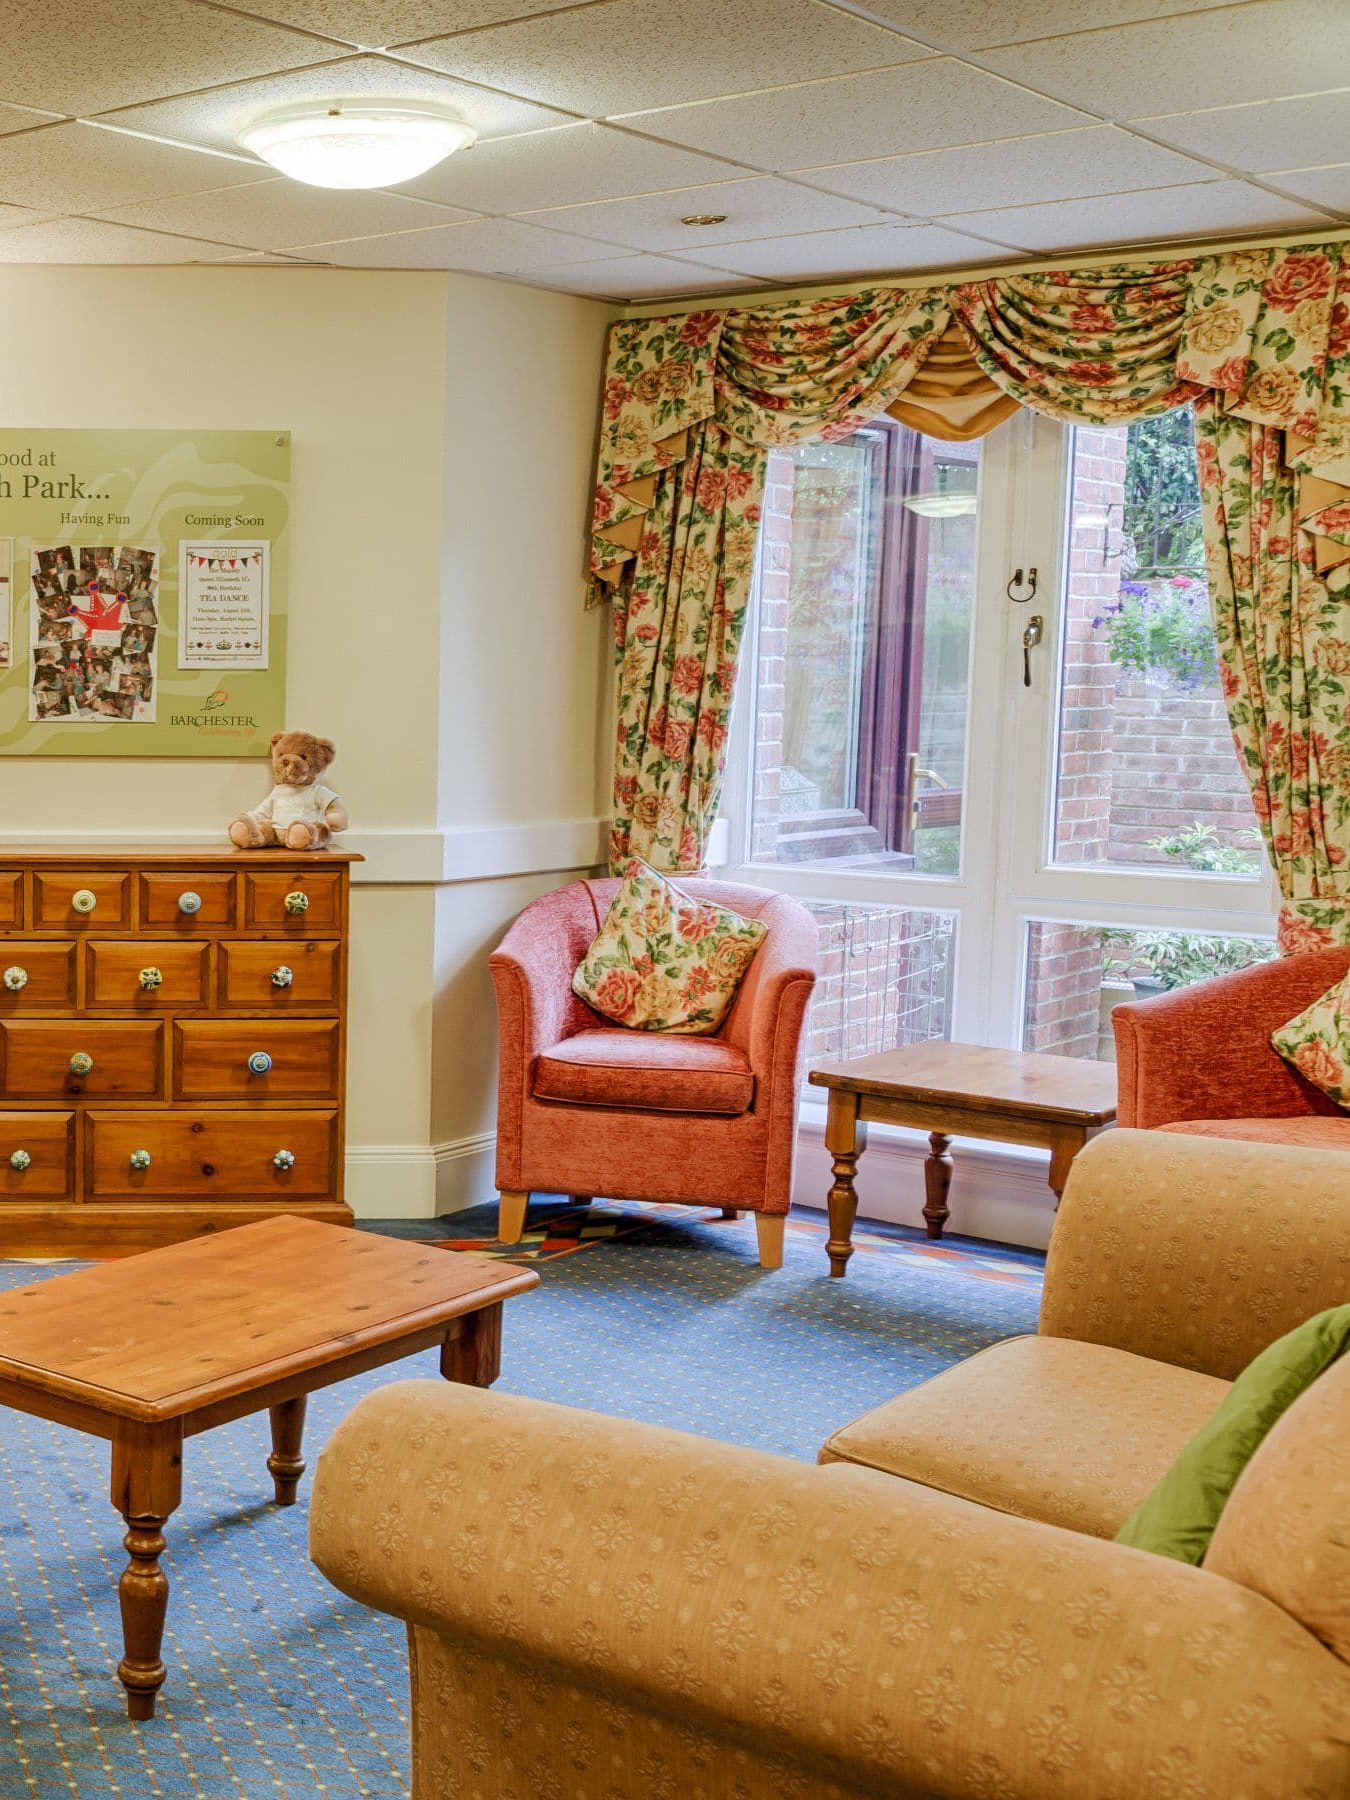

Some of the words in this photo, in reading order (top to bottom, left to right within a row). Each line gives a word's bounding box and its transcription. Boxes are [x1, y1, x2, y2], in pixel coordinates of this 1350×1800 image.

[38, 451, 57, 467] at
[22, 473, 110, 499] Park...
[60, 512, 104, 526] Having
[106, 513, 130, 525] Fun
[185, 514, 232, 528] Coming
[235, 514, 265, 526] Soon
[170, 715, 261, 728] BARCHESTER
